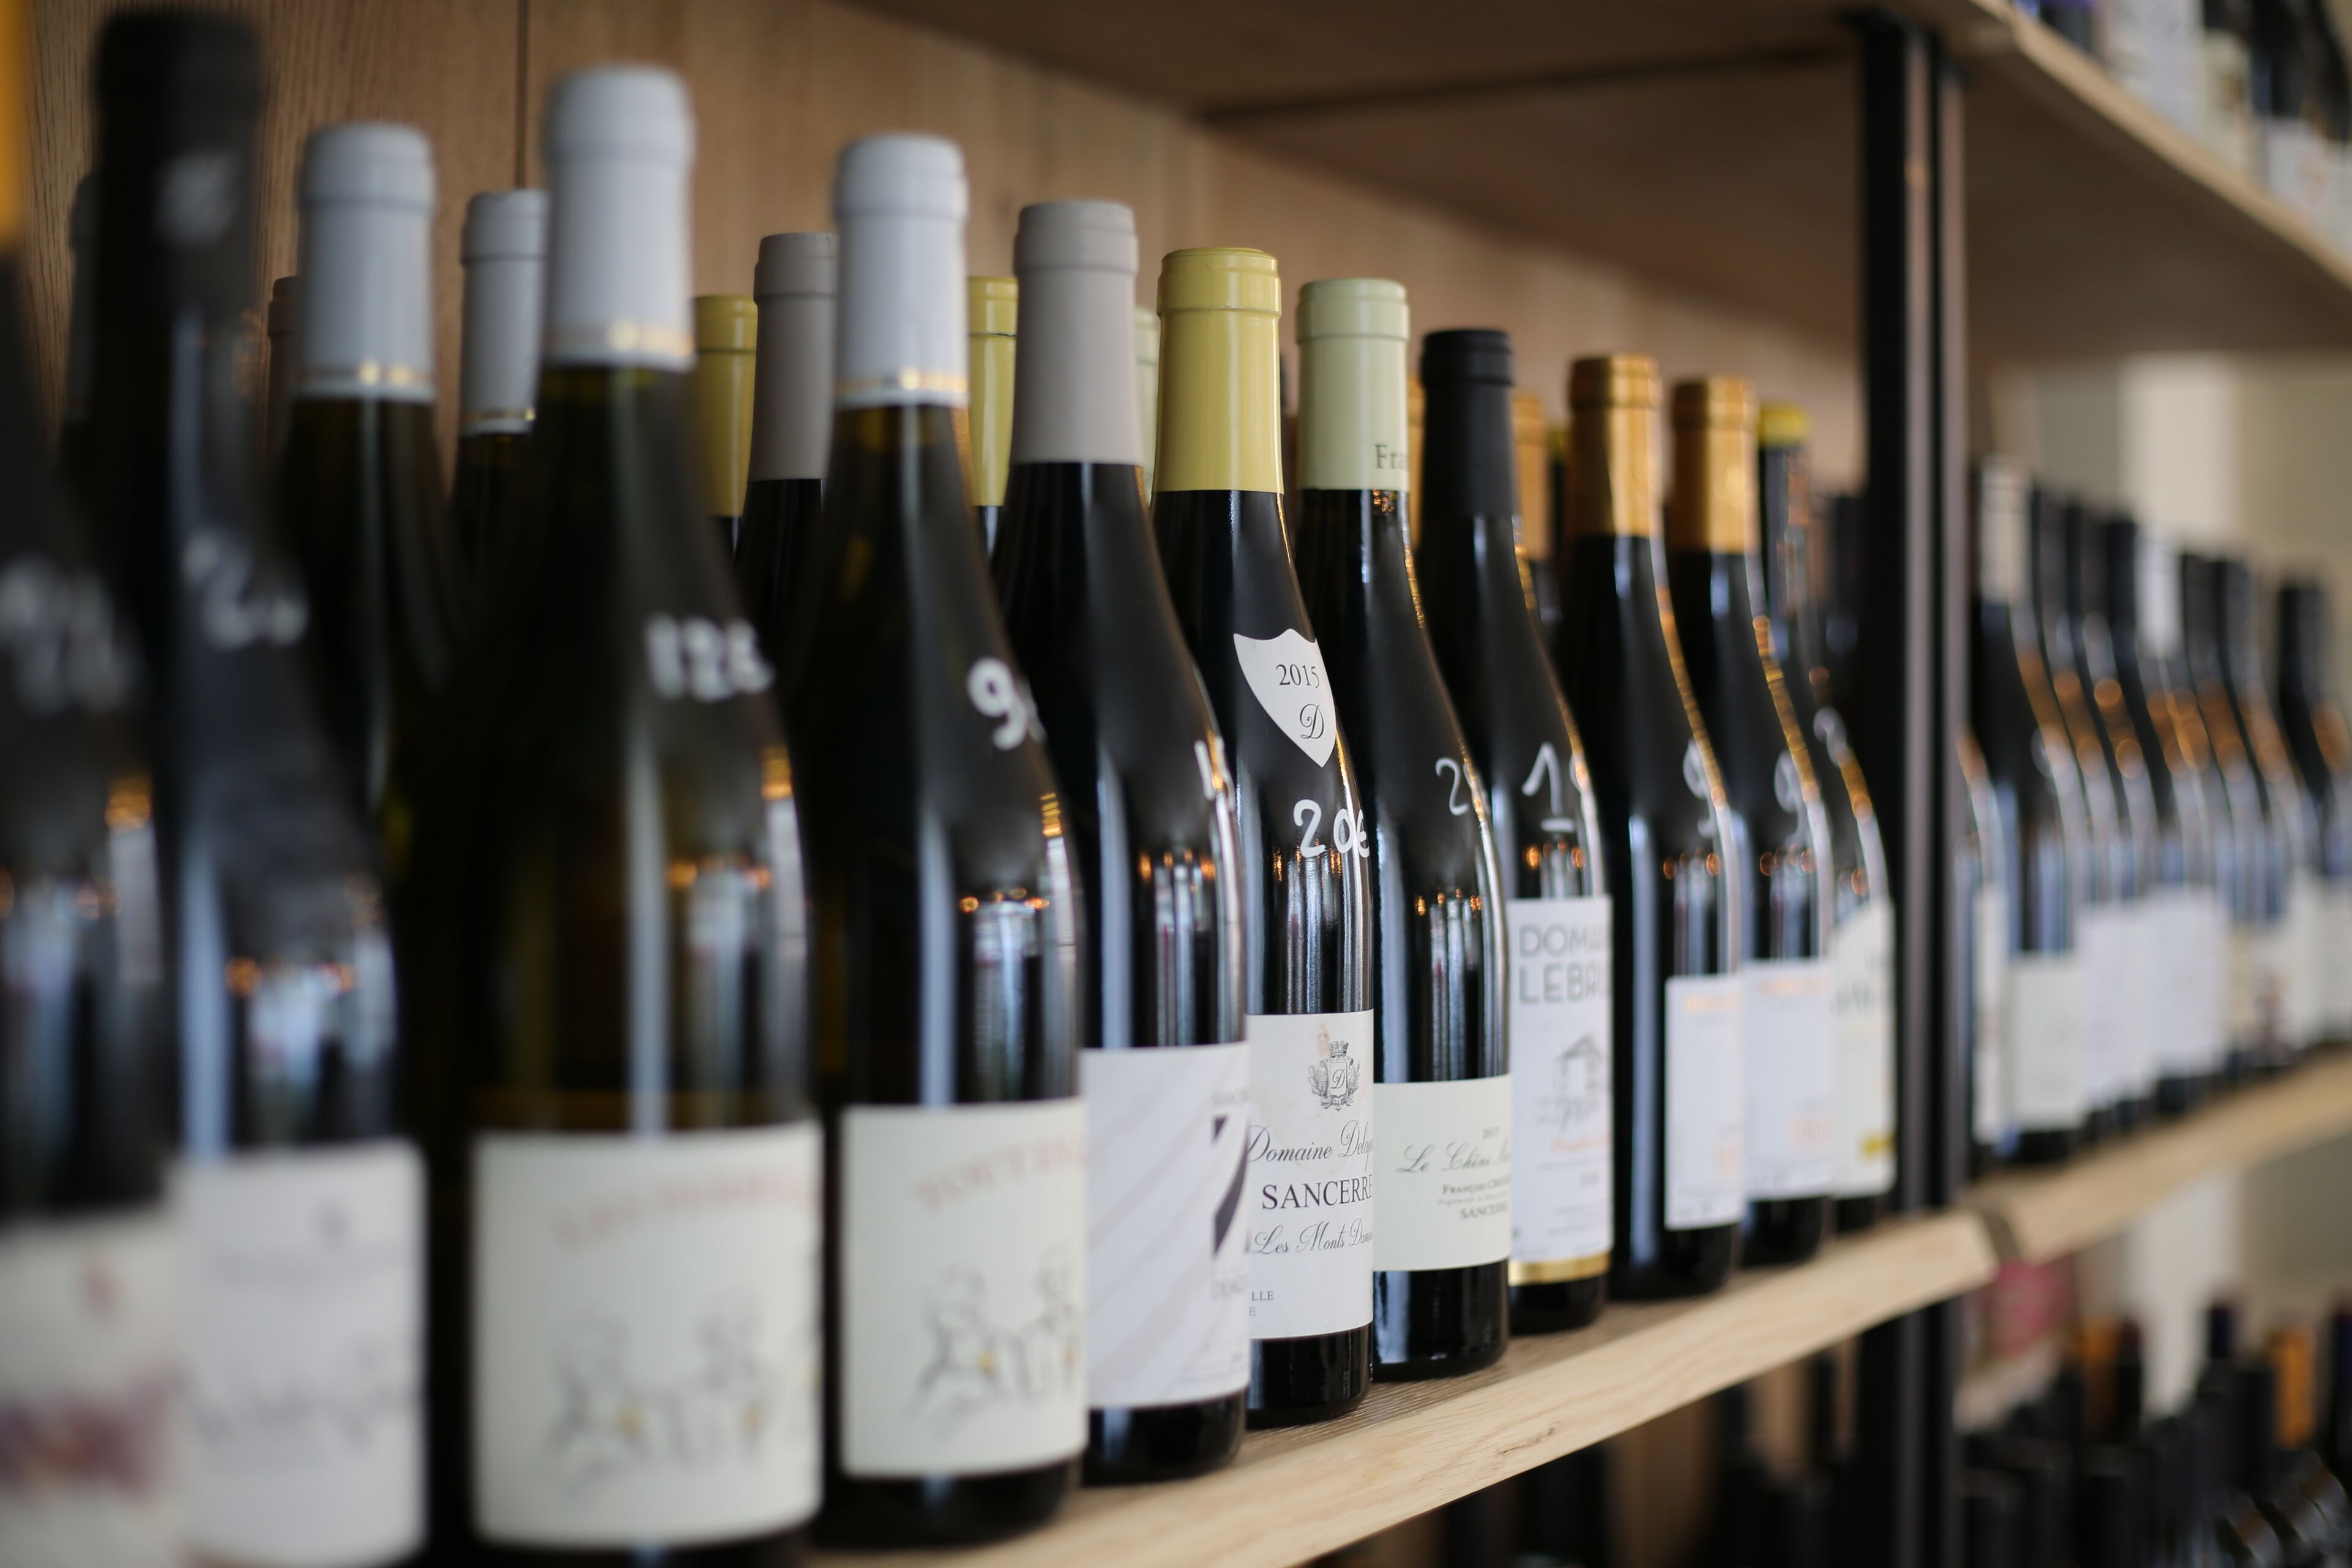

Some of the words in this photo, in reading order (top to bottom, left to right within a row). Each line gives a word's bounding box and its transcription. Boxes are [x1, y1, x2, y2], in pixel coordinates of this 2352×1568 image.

[1275, 663, 1320, 688] 2015
[1300, 703, 1324, 739] D
[1246, 1124, 1333, 1163] Domaine
[1395, 1144, 1435, 1173] Le
[1252, 1224, 1291, 1255] Les
[1295, 1221, 1347, 1253] Monts
